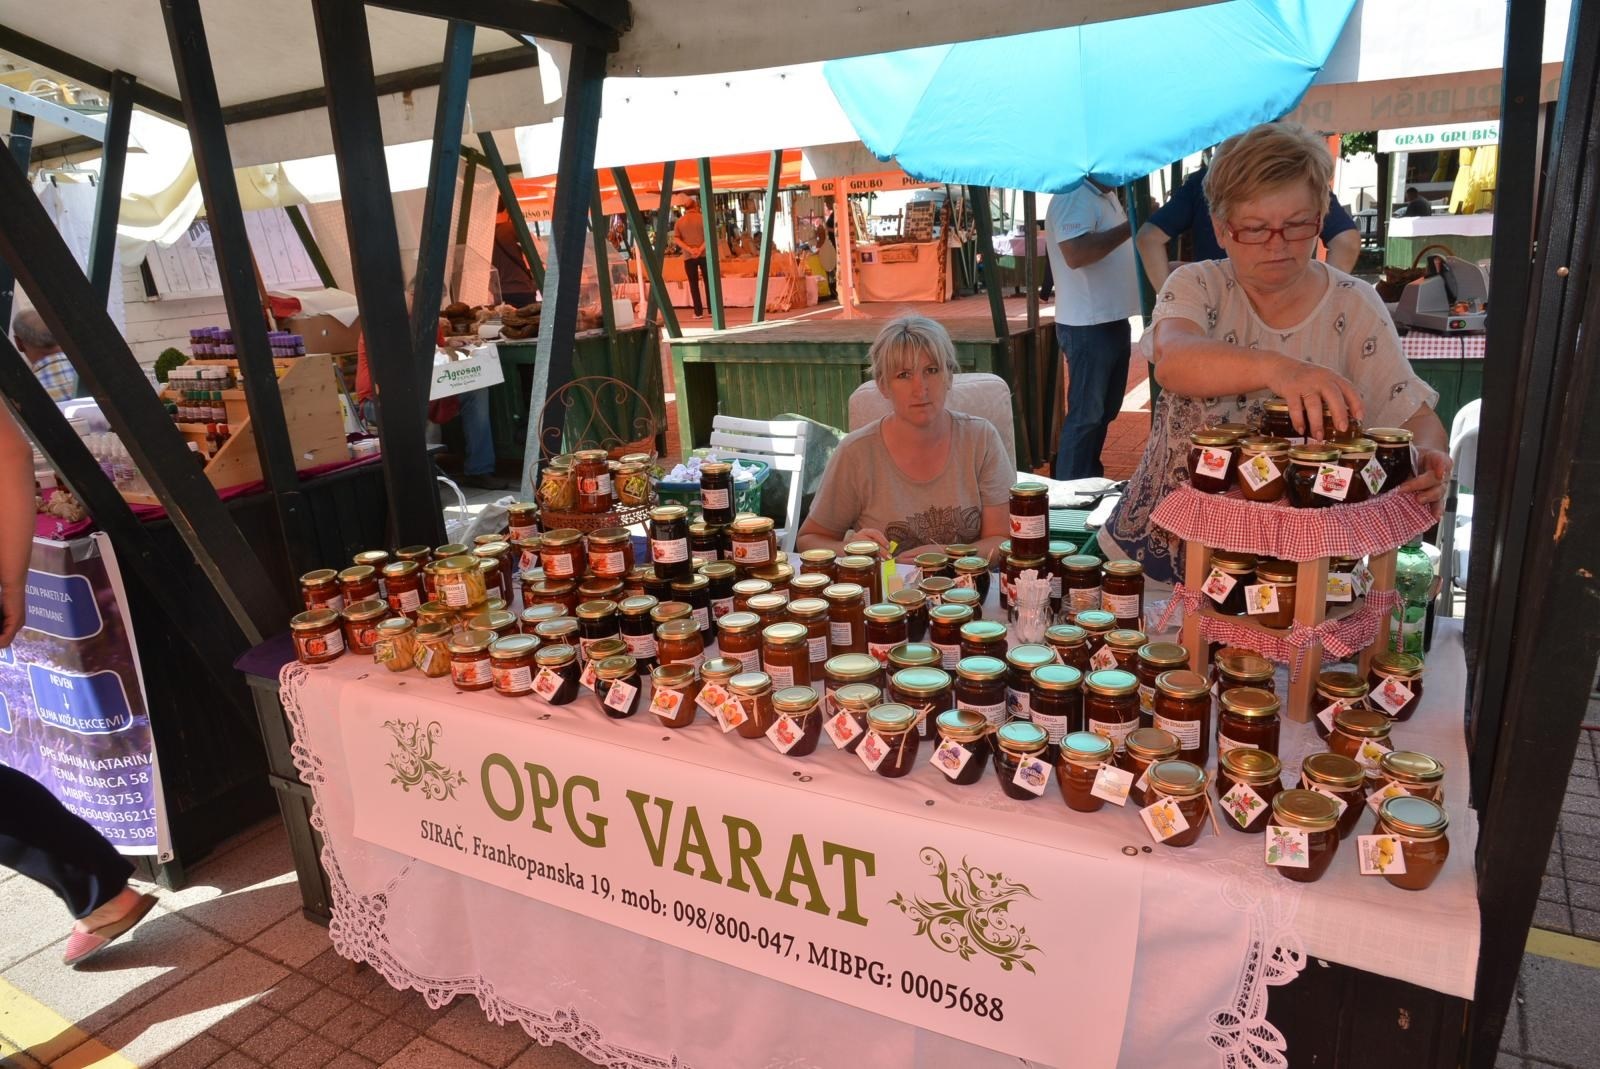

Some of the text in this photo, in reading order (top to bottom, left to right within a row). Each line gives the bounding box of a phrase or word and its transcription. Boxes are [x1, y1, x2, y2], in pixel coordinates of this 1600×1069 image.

[1395, 125, 1499, 146] GRAD GRUBIŠ
[822, 183, 834, 191] GR
[850, 179, 883, 189] GRUBO
[437, 365, 482, 383] Agrosan
[60, 592, 73, 603] ZA
[28, 605, 65, 623] APARTMANE
[49, 674, 74, 690] NEVEN
[40, 707, 58, 723] SUHA
[40, 745, 56, 760] OPG
[129, 772, 149, 786] 58
[61, 785, 144, 806] MIBPG: 233753
[105, 827, 127, 839] 532
[129, 826, 158, 839] 508
[480, 752, 877, 927] OPG VARAT
[420, 819, 1005, 1023] SIRAČ, Frankopanska 19, mob: 098/800-047, MIBPG: 0005688
